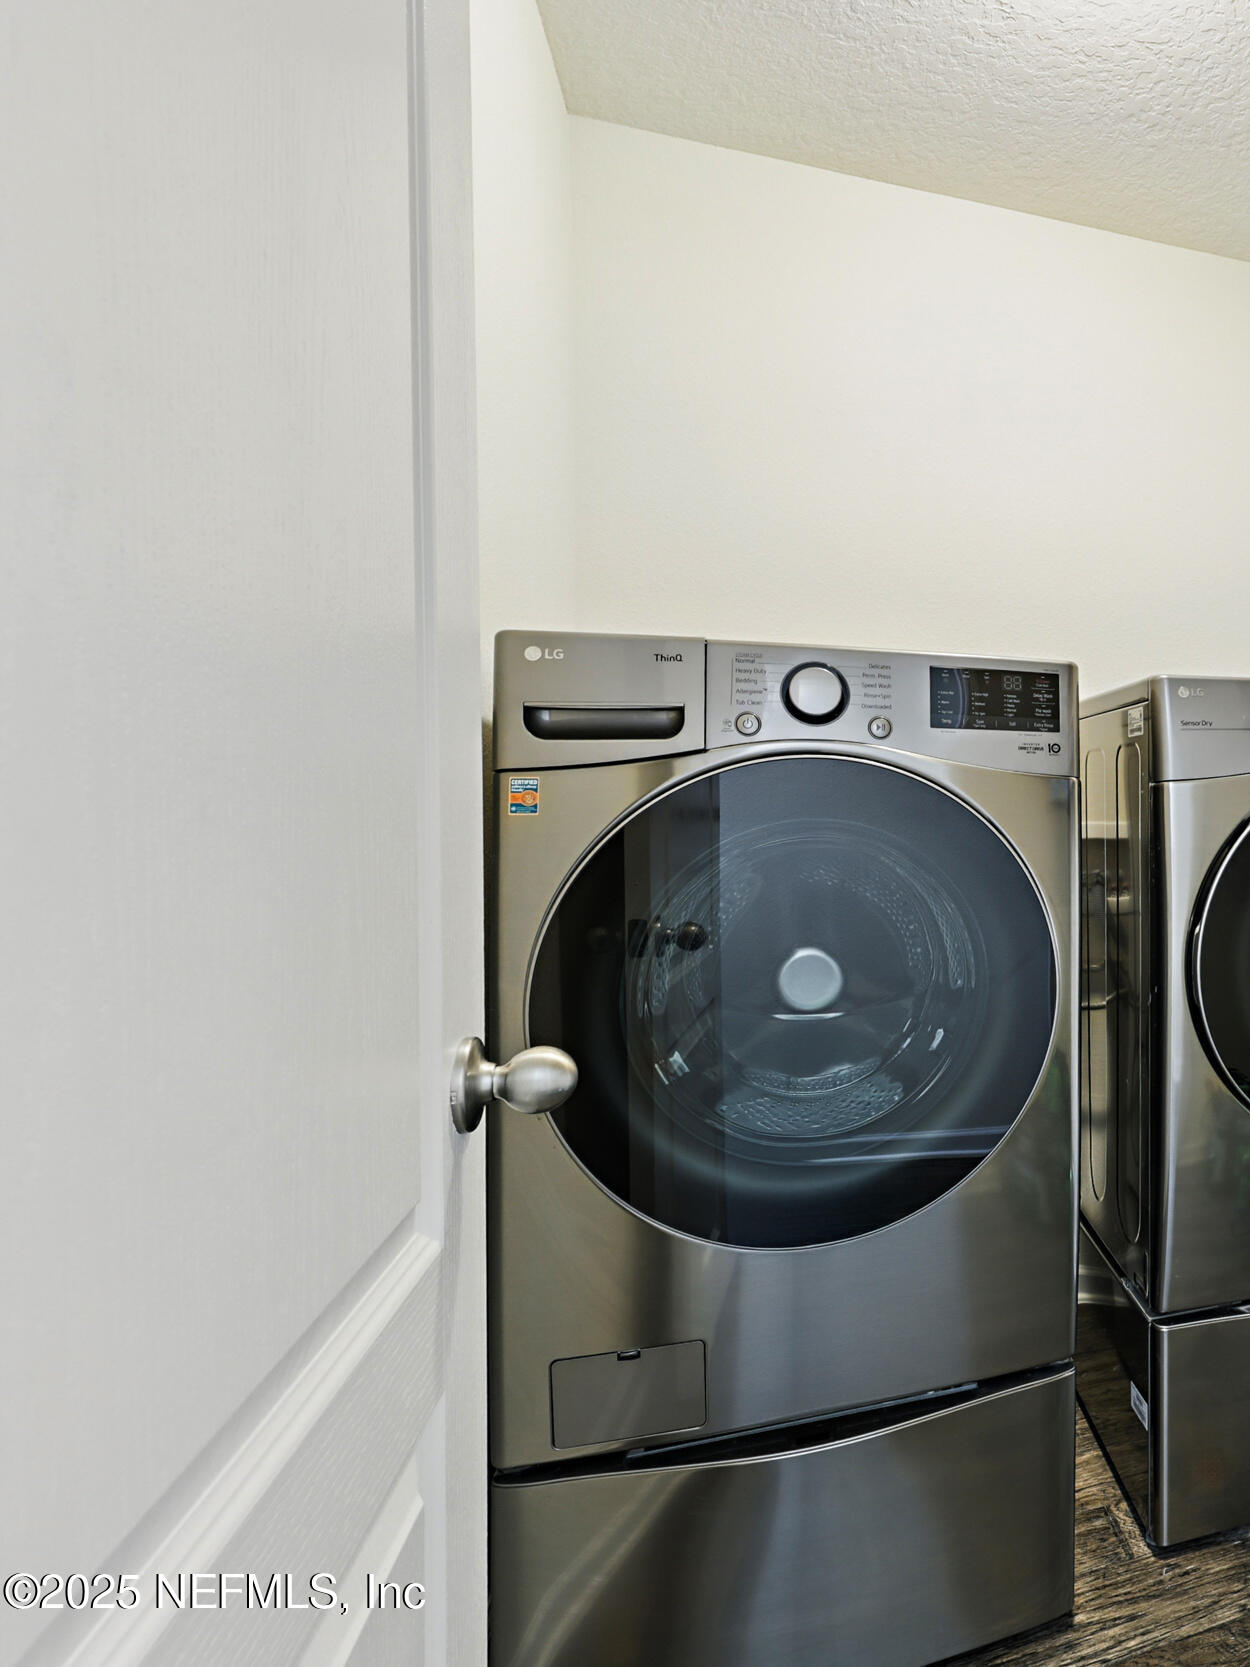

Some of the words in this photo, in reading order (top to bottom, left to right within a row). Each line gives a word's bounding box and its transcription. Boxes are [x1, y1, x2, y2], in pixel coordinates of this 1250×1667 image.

[544, 648, 564, 660] LG
[653, 653, 683, 663] ThinQ
[1190, 687, 1206, 697] LG
[1201, 719, 1213, 728] Dry
